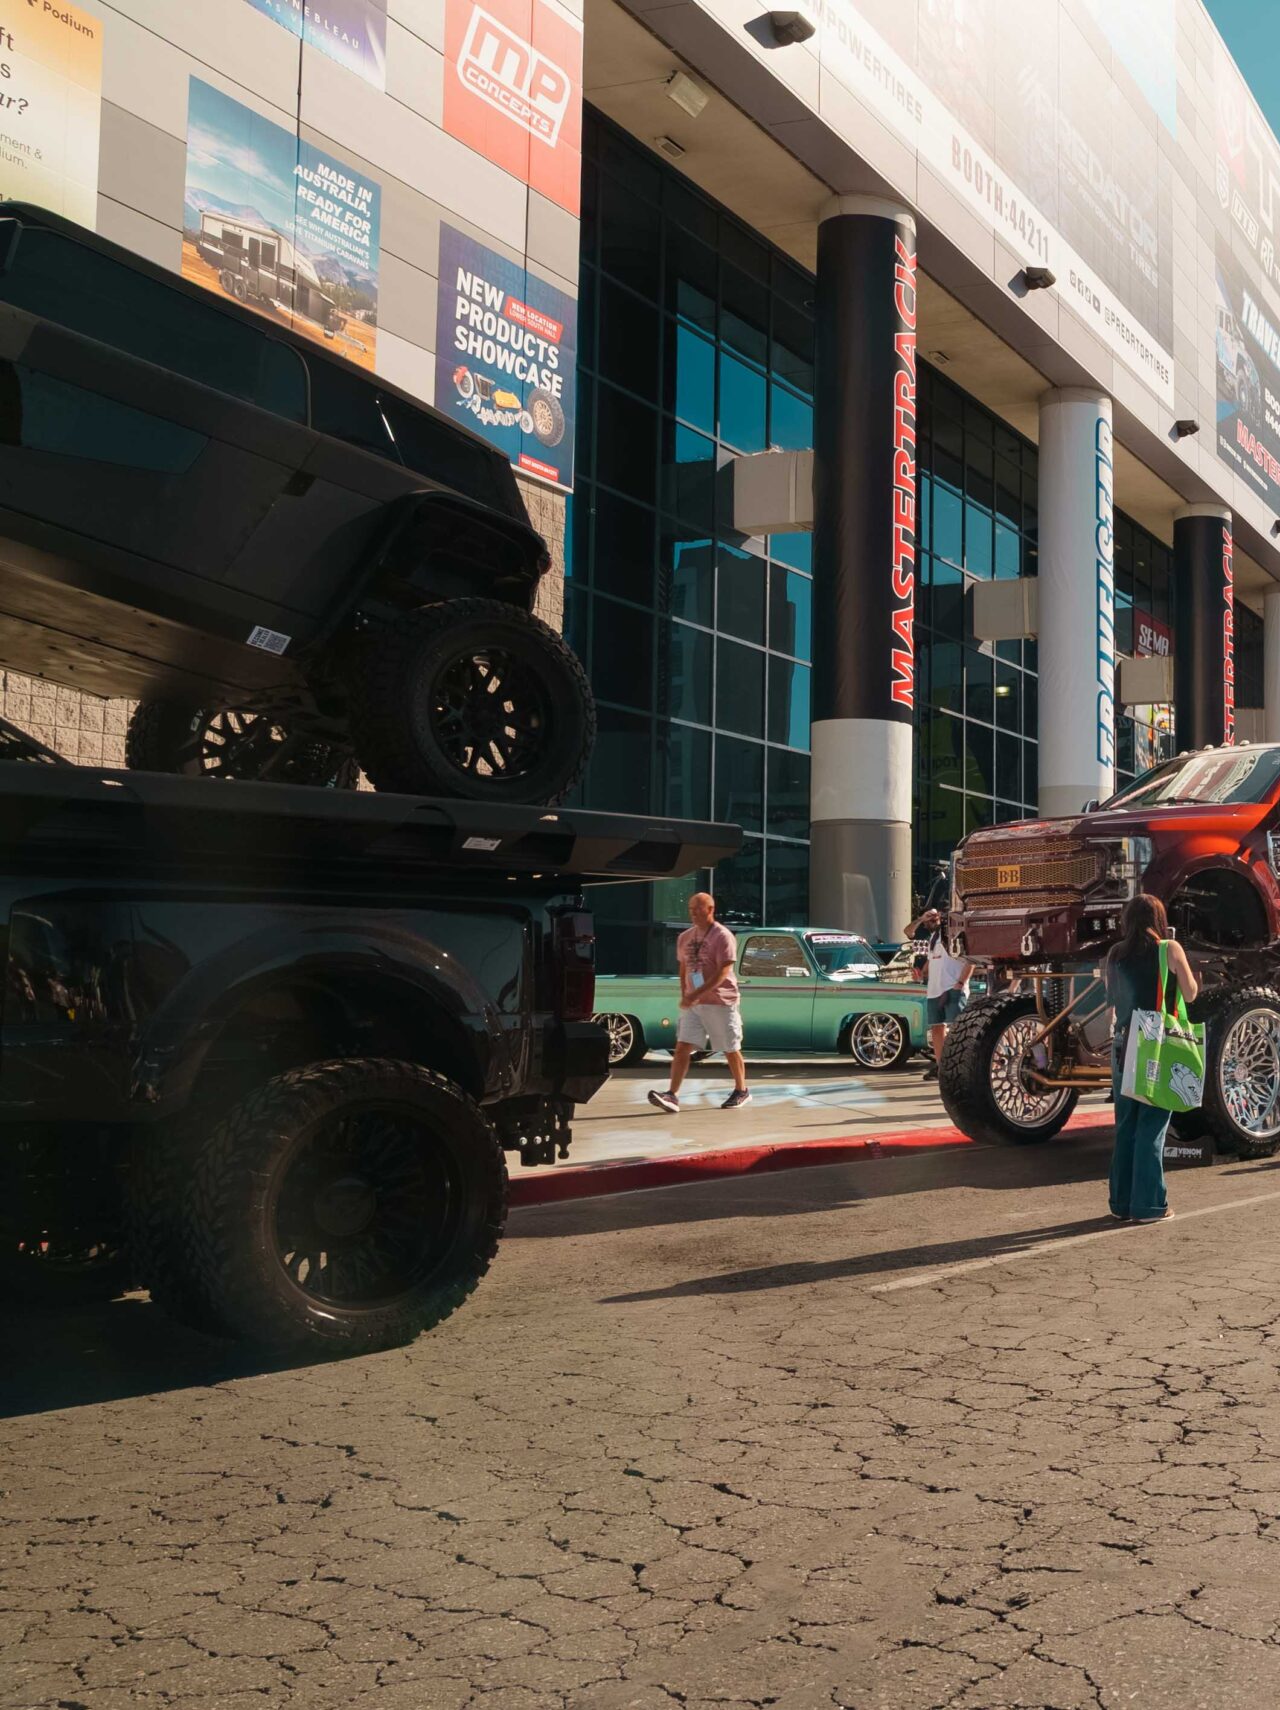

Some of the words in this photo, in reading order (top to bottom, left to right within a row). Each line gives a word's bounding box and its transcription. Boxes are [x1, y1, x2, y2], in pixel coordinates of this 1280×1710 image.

[43, 0, 94, 38] Podium
[285, 0, 359, 49] NEBLEAU
[466, 67, 550, 133] CONCEPTS
[0, 146, 28, 169] ium.
[34, 148, 42, 160] &
[293, 164, 371, 218] AUSTRALIA,
[317, 163, 355, 194] MADE
[357, 186, 373, 203] IN
[952, 134, 1050, 263] BOOTH:44211
[297, 185, 343, 217] READY
[344, 211, 371, 234] FOR
[311, 207, 370, 247] AMERICA
[336, 248, 369, 270] CARAVANS
[457, 267, 504, 312] NEW
[455, 295, 559, 369] PRODUCTS
[511, 302, 525, 316] NEW
[527, 308, 558, 332] LOCATION
[454, 325, 563, 399] SHOWCASE
[891, 234, 917, 710] MASTERTRACK
[1138, 624, 1169, 656] SEMA
[1222, 526, 1235, 746] STERTRACK
[1178, 1147, 1203, 1155] VENOM
